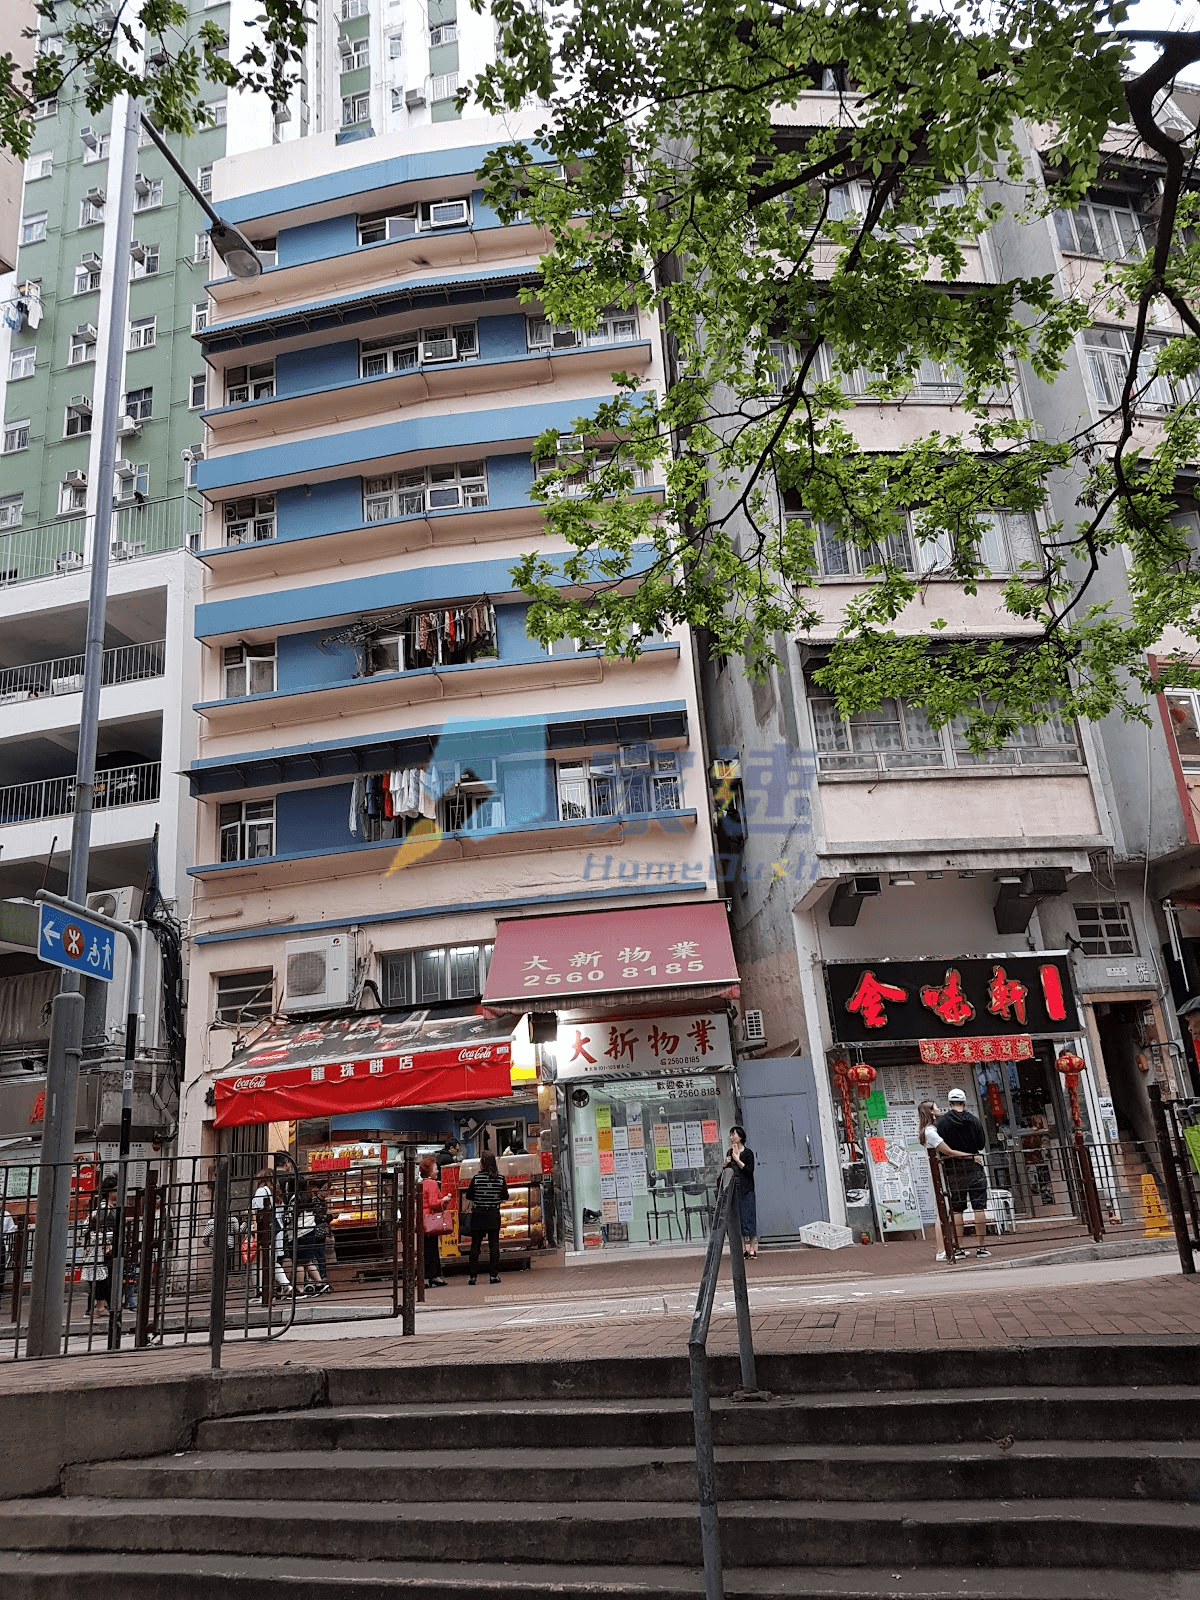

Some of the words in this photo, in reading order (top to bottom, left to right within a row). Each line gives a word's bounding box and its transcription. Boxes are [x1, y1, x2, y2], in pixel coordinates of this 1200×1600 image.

[522, 941, 700, 971] 大新物業
[523, 970, 605, 987] 2560
[621, 960, 705, 978] 8185
[569, 1019, 716, 1064] 大新物業
[458, 1046, 493, 1062] Coca-Cola
[667, 1057, 684, 1066] 2560
[684, 1056, 700, 1064] 8185
[311, 1056, 413, 1081] 龍珠餅店
[233, 1074, 268, 1090] Coca-Cola
[678, 1089, 699, 1098] 2560
[702, 1087, 721, 1096] 8185
